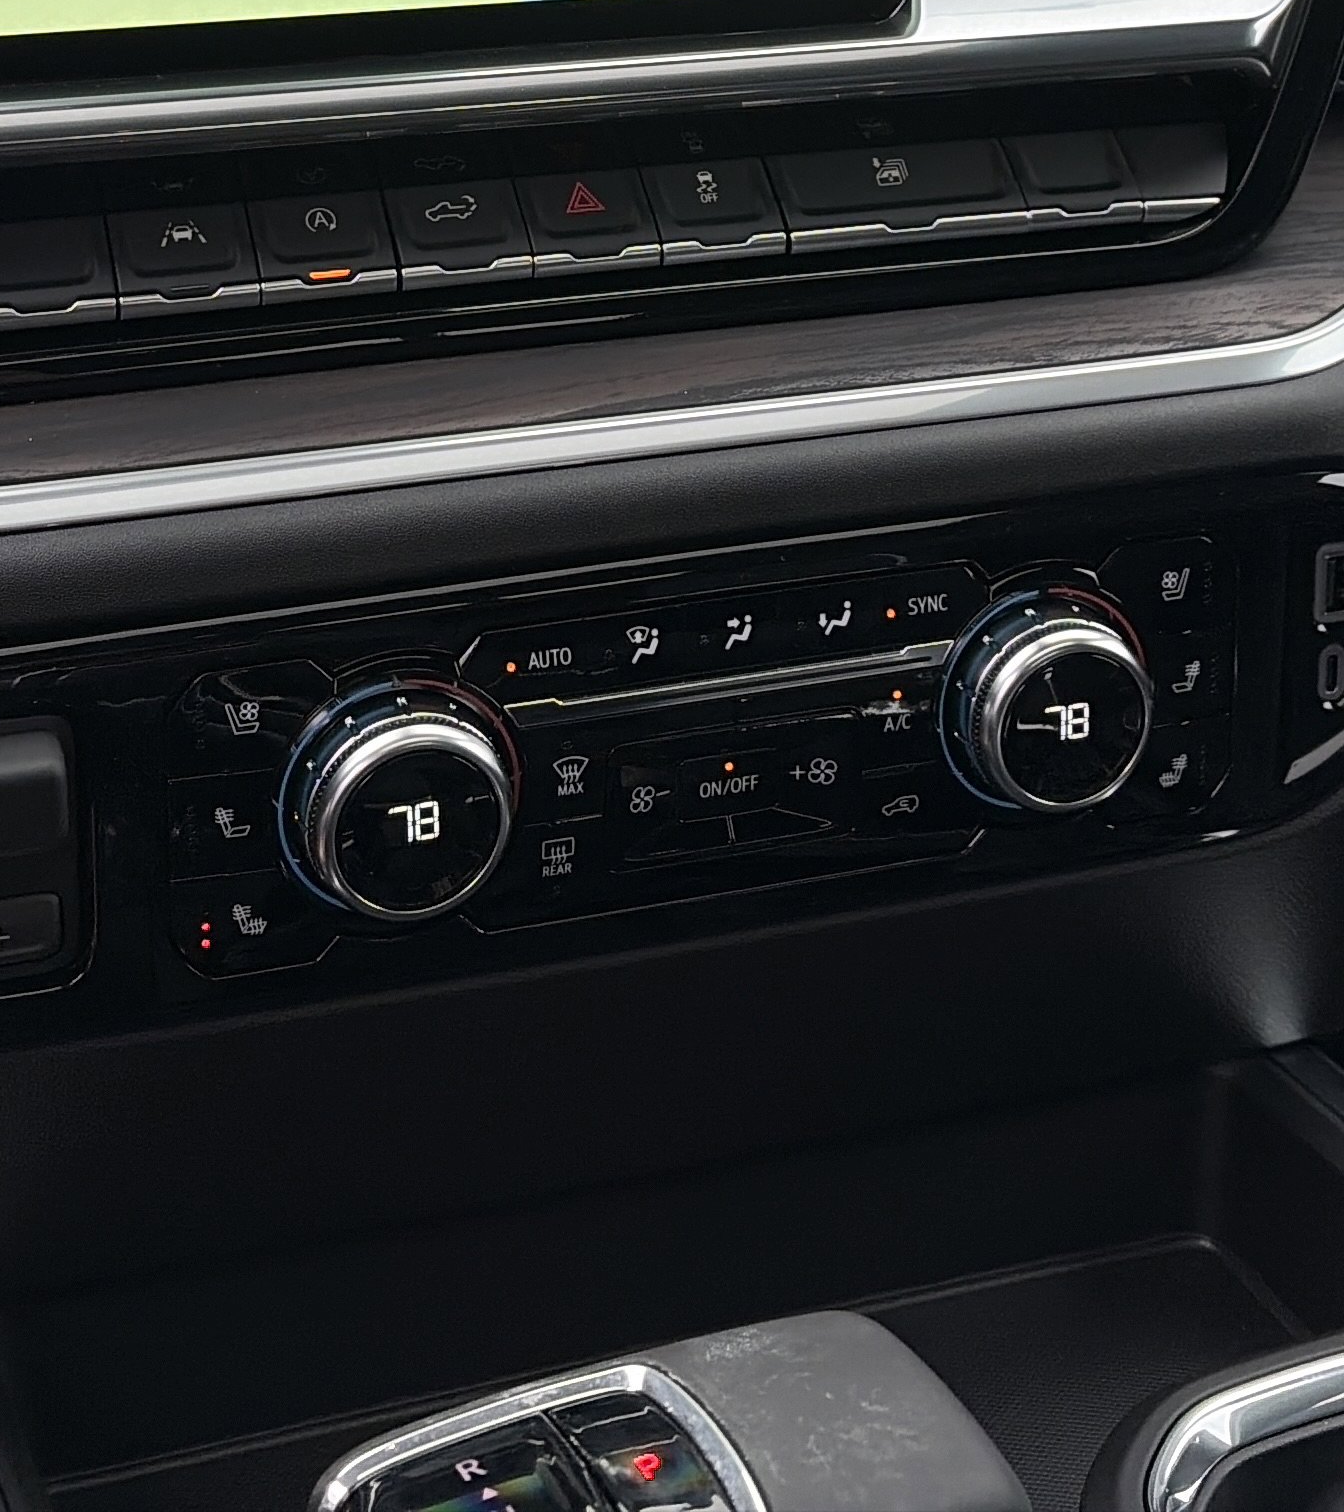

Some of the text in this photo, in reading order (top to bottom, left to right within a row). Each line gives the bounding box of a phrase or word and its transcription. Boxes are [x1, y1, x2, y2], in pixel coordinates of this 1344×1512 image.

[699, 192, 718, 204] OFF
[314, 211, 329, 228] A
[907, 593, 949, 616] SYNC
[528, 647, 572, 670] AUTO
[883, 714, 911, 732] A/C
[1044, 702, 1090, 741] 78
[557, 782, 584, 797] MAX
[699, 774, 760, 799] ON/OFF
[387, 800, 440, 843] 78
[542, 862, 572, 878] REAR
[455, 1458, 488, 1482] R
